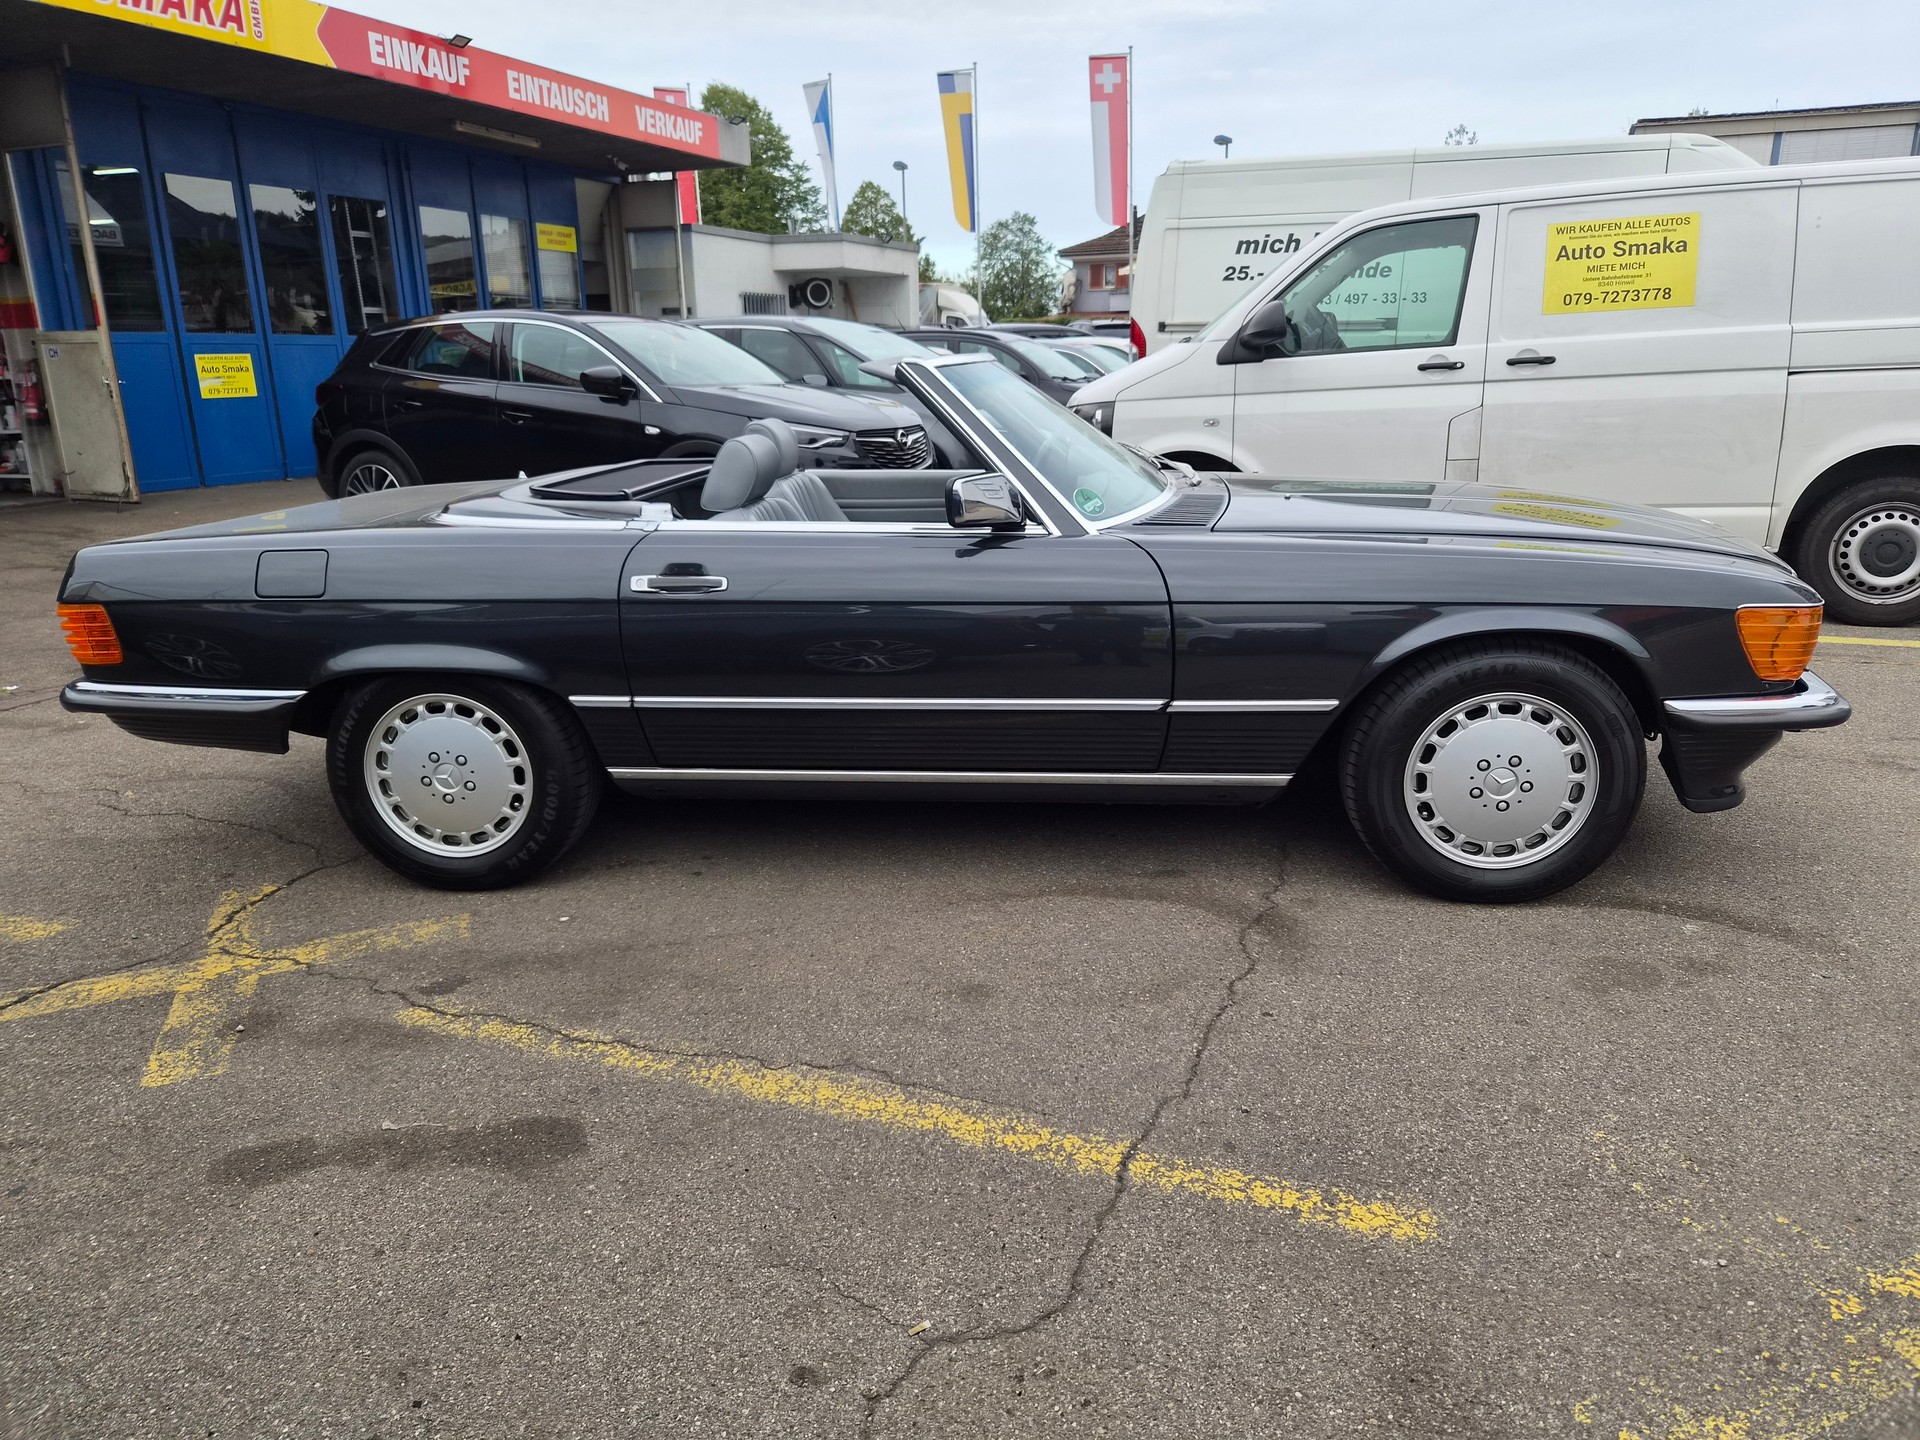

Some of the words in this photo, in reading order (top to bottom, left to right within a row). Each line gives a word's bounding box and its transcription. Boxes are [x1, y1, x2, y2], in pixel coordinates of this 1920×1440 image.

[368, 30, 470, 87] EINKAUF
[506, 69, 610, 123] EINTAUSCH
[635, 104, 703, 145] VERKAUF
[1556, 225, 1576, 235] WIR
[1579, 222, 1622, 234] KAUFEN
[1624, 219, 1651, 230] ALLE
[1653, 216, 1691, 228] AUTOS
[1235, 233, 1301, 254] mich
[1555, 244, 1606, 261] Auto
[1613, 236, 1688, 257] Smaka
[1222, 266, 1264, 281] 25.-
[1586, 264, 1617, 273] MIETE
[1619, 261, 1646, 271] MICH
[1601, 273, 1643, 281] Bahnhofstrasse
[1344, 293, 1368, 304] 497
[1381, 292, 1398, 304] 33
[1411, 292, 1428, 303] 33
[1563, 287, 1672, 306] 079-7273778
[201, 365, 220, 373] Auto
[222, 364, 250, 373] Smaka
